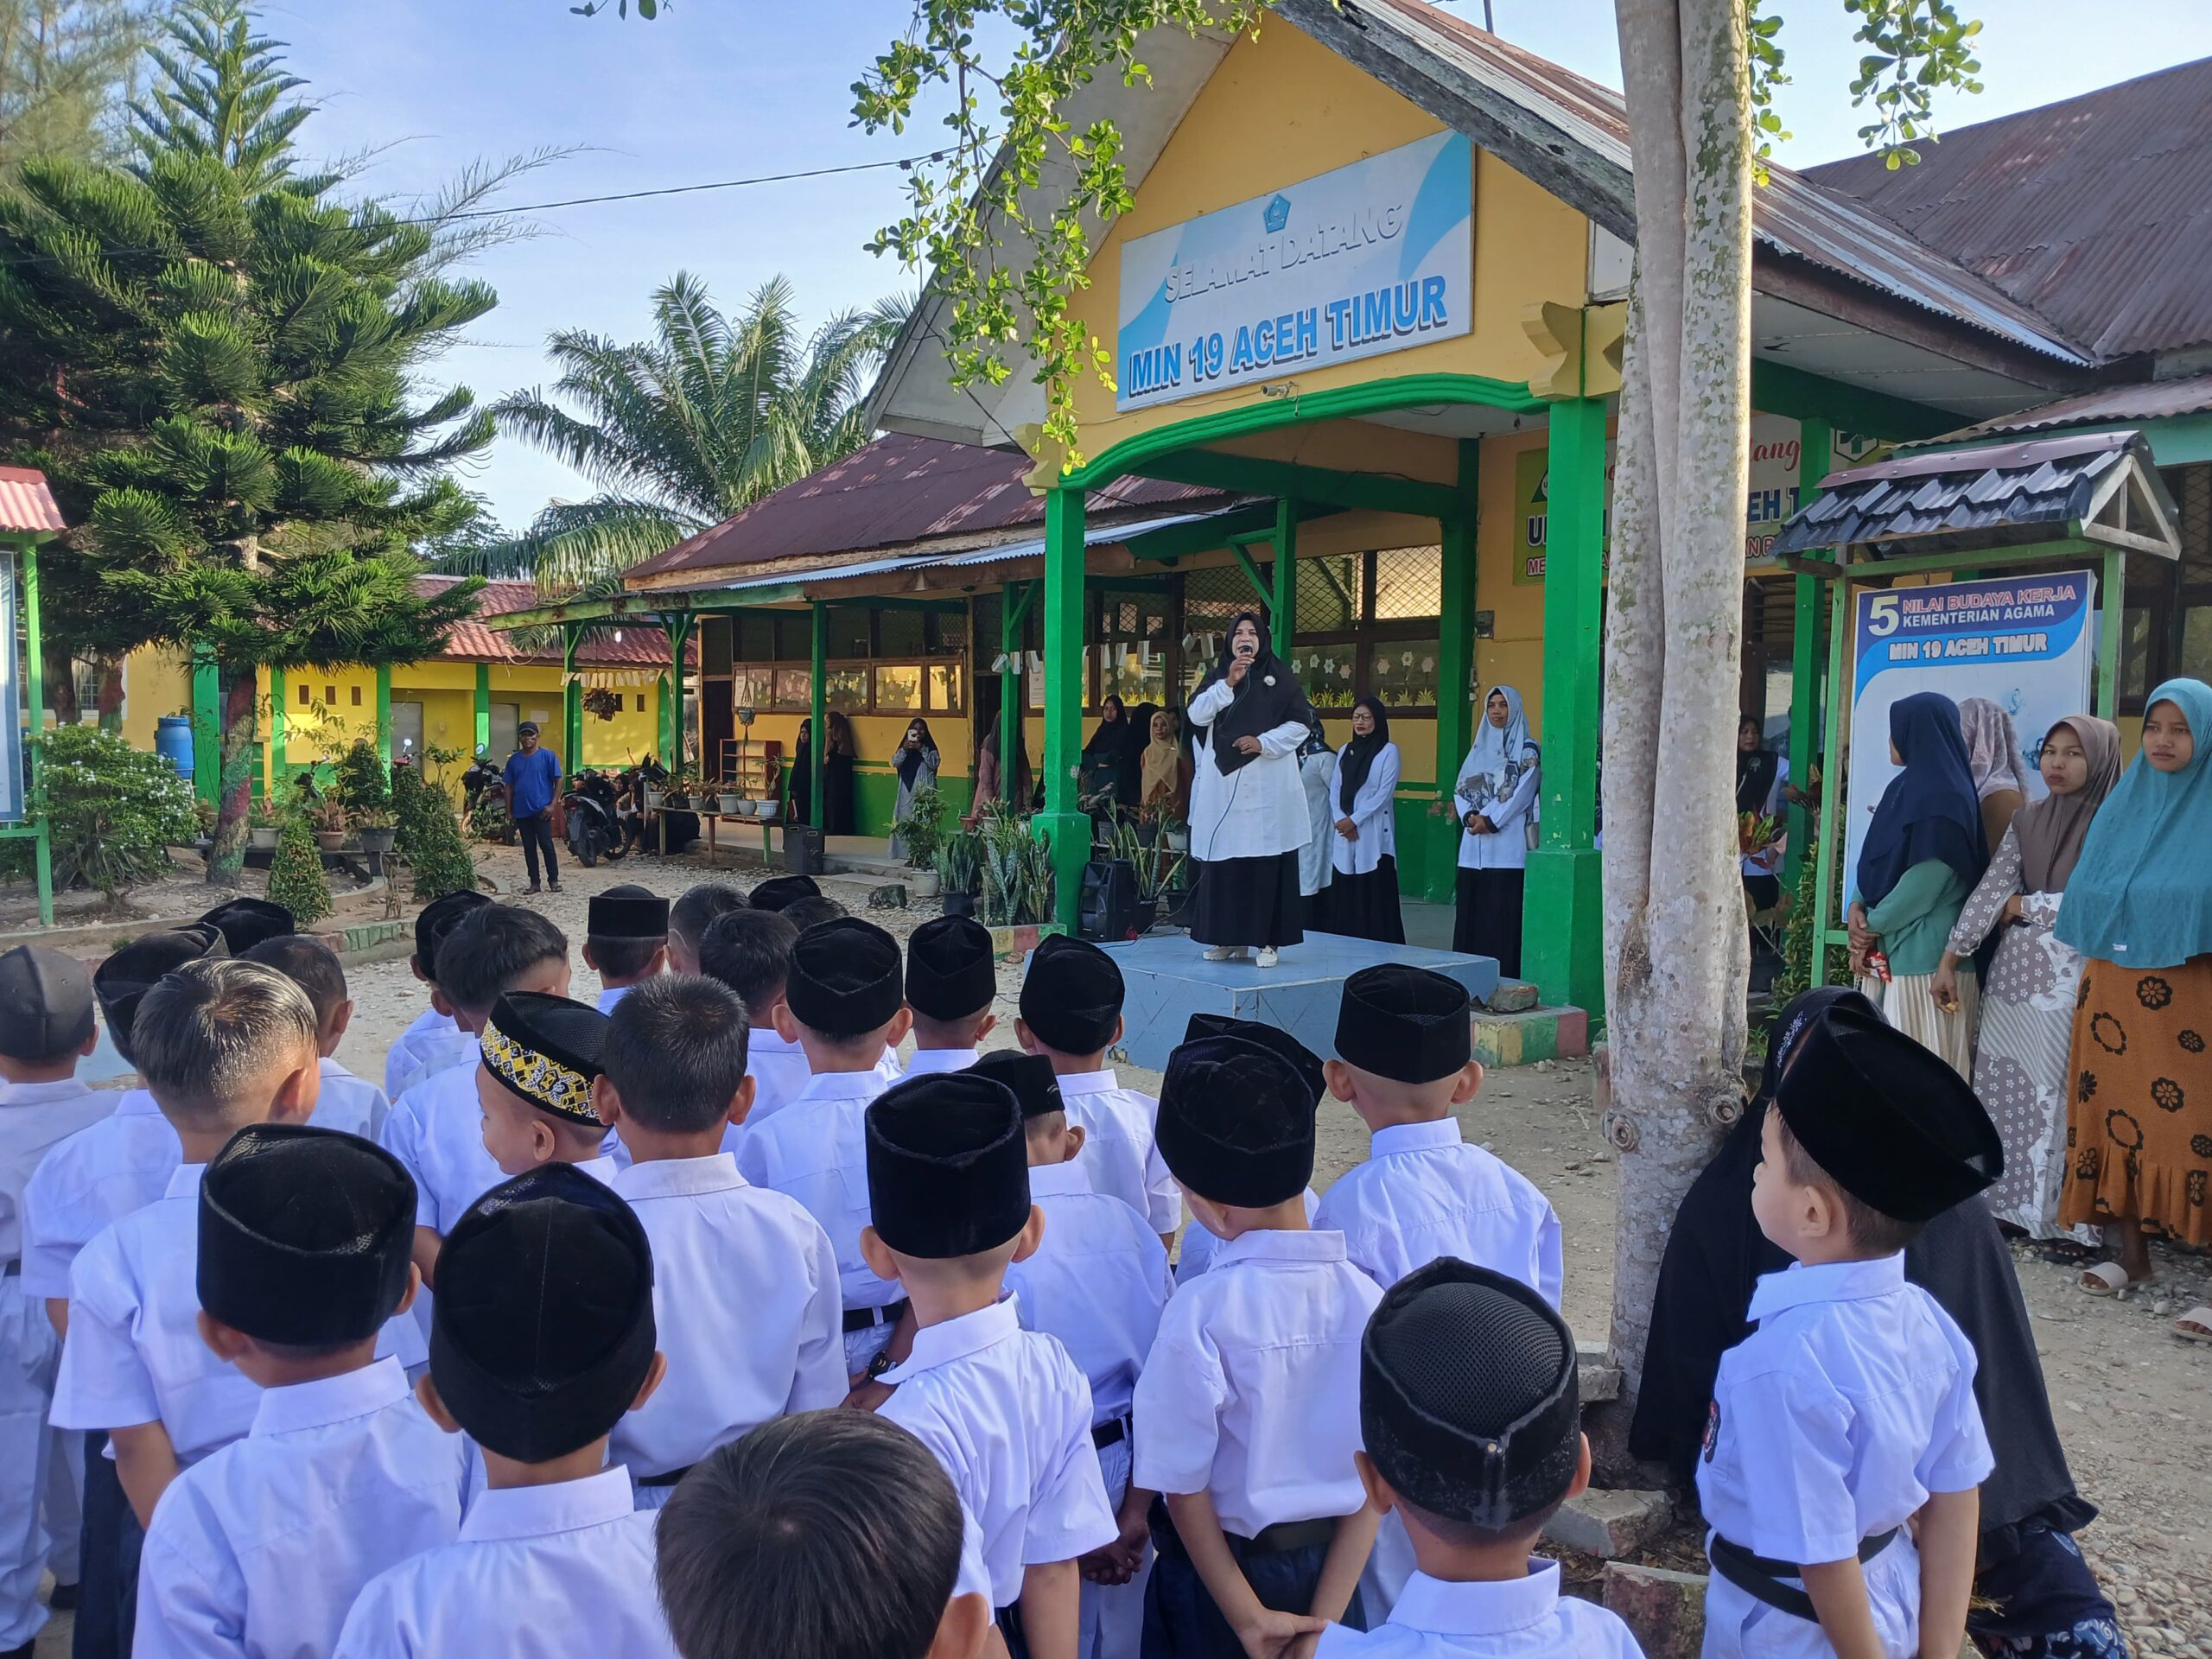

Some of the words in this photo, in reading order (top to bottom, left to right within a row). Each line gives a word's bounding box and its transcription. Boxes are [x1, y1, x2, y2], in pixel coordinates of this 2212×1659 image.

[1164, 245, 1274, 302] SELAMAT
[1281, 206, 1402, 269] DATANG
[1128, 342, 1181, 397] MIN
[1189, 332, 1224, 382] 19
[1230, 306, 1318, 373] ACEH
[1325, 275, 1448, 350] TIMUR
[1750, 437, 1801, 471] ang
[1868, 594, 1899, 636] 5
[1903, 597, 1944, 614] NILAI
[1948, 590, 2014, 611] BUDAYA
[2017, 585, 2075, 605] KERJA
[1903, 608, 1999, 628] KEMENTERIAN
[2004, 604, 2055, 620] AGAMA
[1889, 641, 1918, 661] MIN
[1922, 639, 1942, 658] 19
[1943, 637, 1989, 658] ACEH
[1993, 632, 2048, 653] TIMUR
